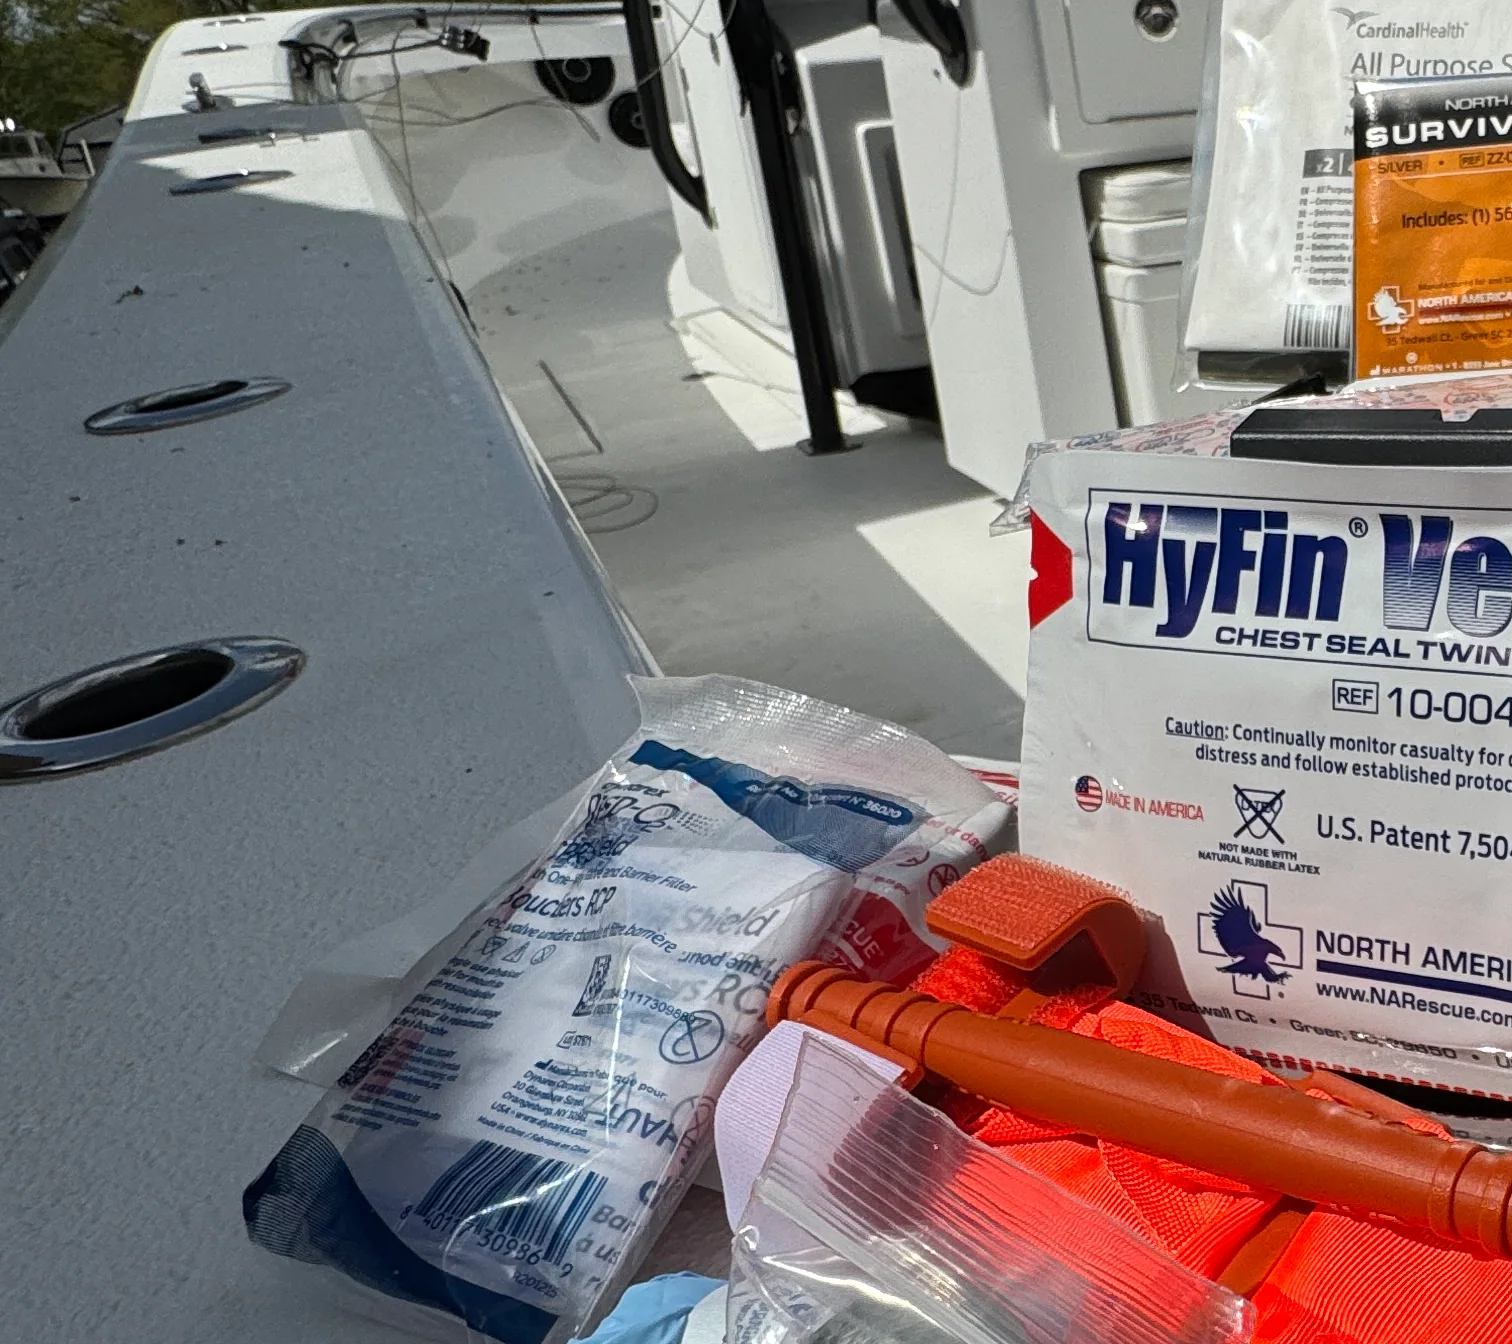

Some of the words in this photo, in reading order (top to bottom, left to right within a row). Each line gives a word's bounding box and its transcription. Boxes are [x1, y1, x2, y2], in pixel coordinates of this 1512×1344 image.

[1350, 52, 1382, 76] All
[1446, 95, 1507, 111] NORTH
[1378, 159, 1423, 175] SILVER
[1401, 211, 1469, 230] Includes:
[1472, 207, 1491, 226] (1)
[1418, 297, 1457, 308] NORTH
[1215, 626, 1322, 651] CHEST
[1325, 634, 1411, 659] SEAL
[1417, 640, 1511, 667] TWIN
[1337, 686, 1375, 707] REF
[1165, 716, 1229, 740] Caution:
[1232, 723, 1325, 751] Continually
[1329, 735, 1397, 755] monitor
[1400, 741, 1475, 767] casualty
[1478, 747, 1505, 766] for
[1195, 744, 1257, 766] distress
[1261, 752, 1291, 769] and
[1294, 755, 1348, 775] follow
[1352, 761, 1451, 787] established
[1105, 790, 1131, 811] MADE
[1133, 797, 1146, 813] IN
[1149, 799, 1205, 822] AMERICA
[1317, 814, 1363, 842] U.S.
[1370, 819, 1452, 854] Patent
[1198, 850, 1242, 866] NATURAL
[1245, 858, 1286, 871] RUBBER
[1288, 863, 1321, 875] LATEX
[1218, 842, 1240, 853] NOT
[1241, 844, 1270, 858] MADE
[1272, 848, 1298, 861] WITH
[662, 875, 698, 893] Filter
[1315, 929, 1411, 966] NORTH
[1290, 1018, 1348, 1041] Greer,
[512, 1080, 526, 1091] 10
[491, 1100, 512, 1115] USA
[590, 1204, 636, 1234] Bar
[400, 1205, 413, 1221] 8
[476, 1233, 543, 1266] 30986
[560, 1262, 573, 1279] 9
